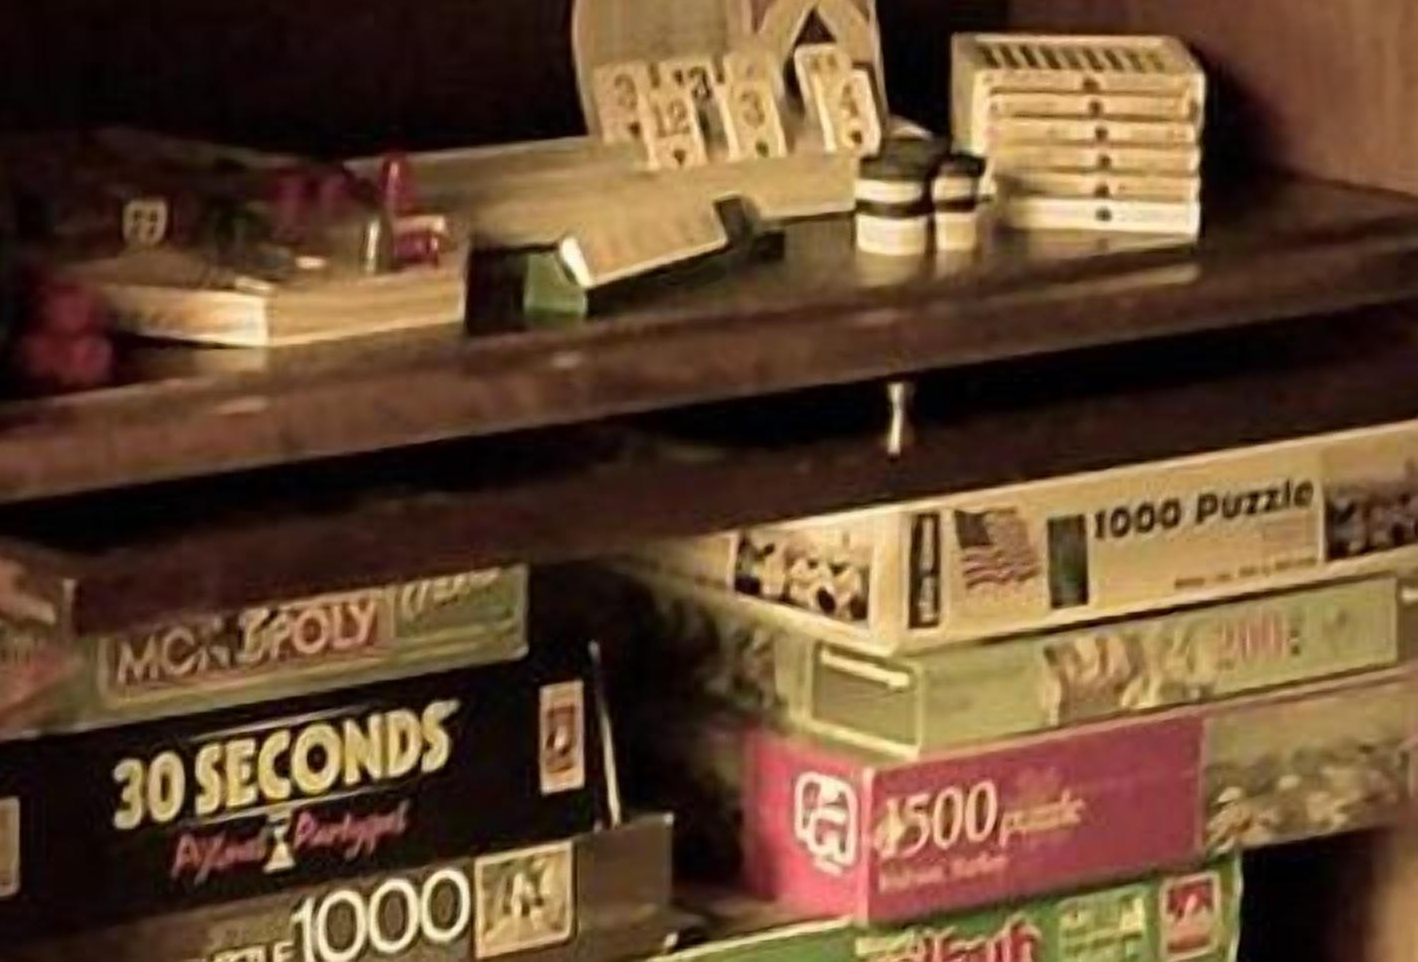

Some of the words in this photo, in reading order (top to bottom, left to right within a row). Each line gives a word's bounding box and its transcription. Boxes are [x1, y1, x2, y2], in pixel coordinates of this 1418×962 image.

[1093, 497, 1183, 541] 1000
[1194, 478, 1315, 527] Puzzle
[112, 752, 184, 831] 30
[195, 696, 462, 818] SECONDS
[290, 868, 472, 962] 1000
